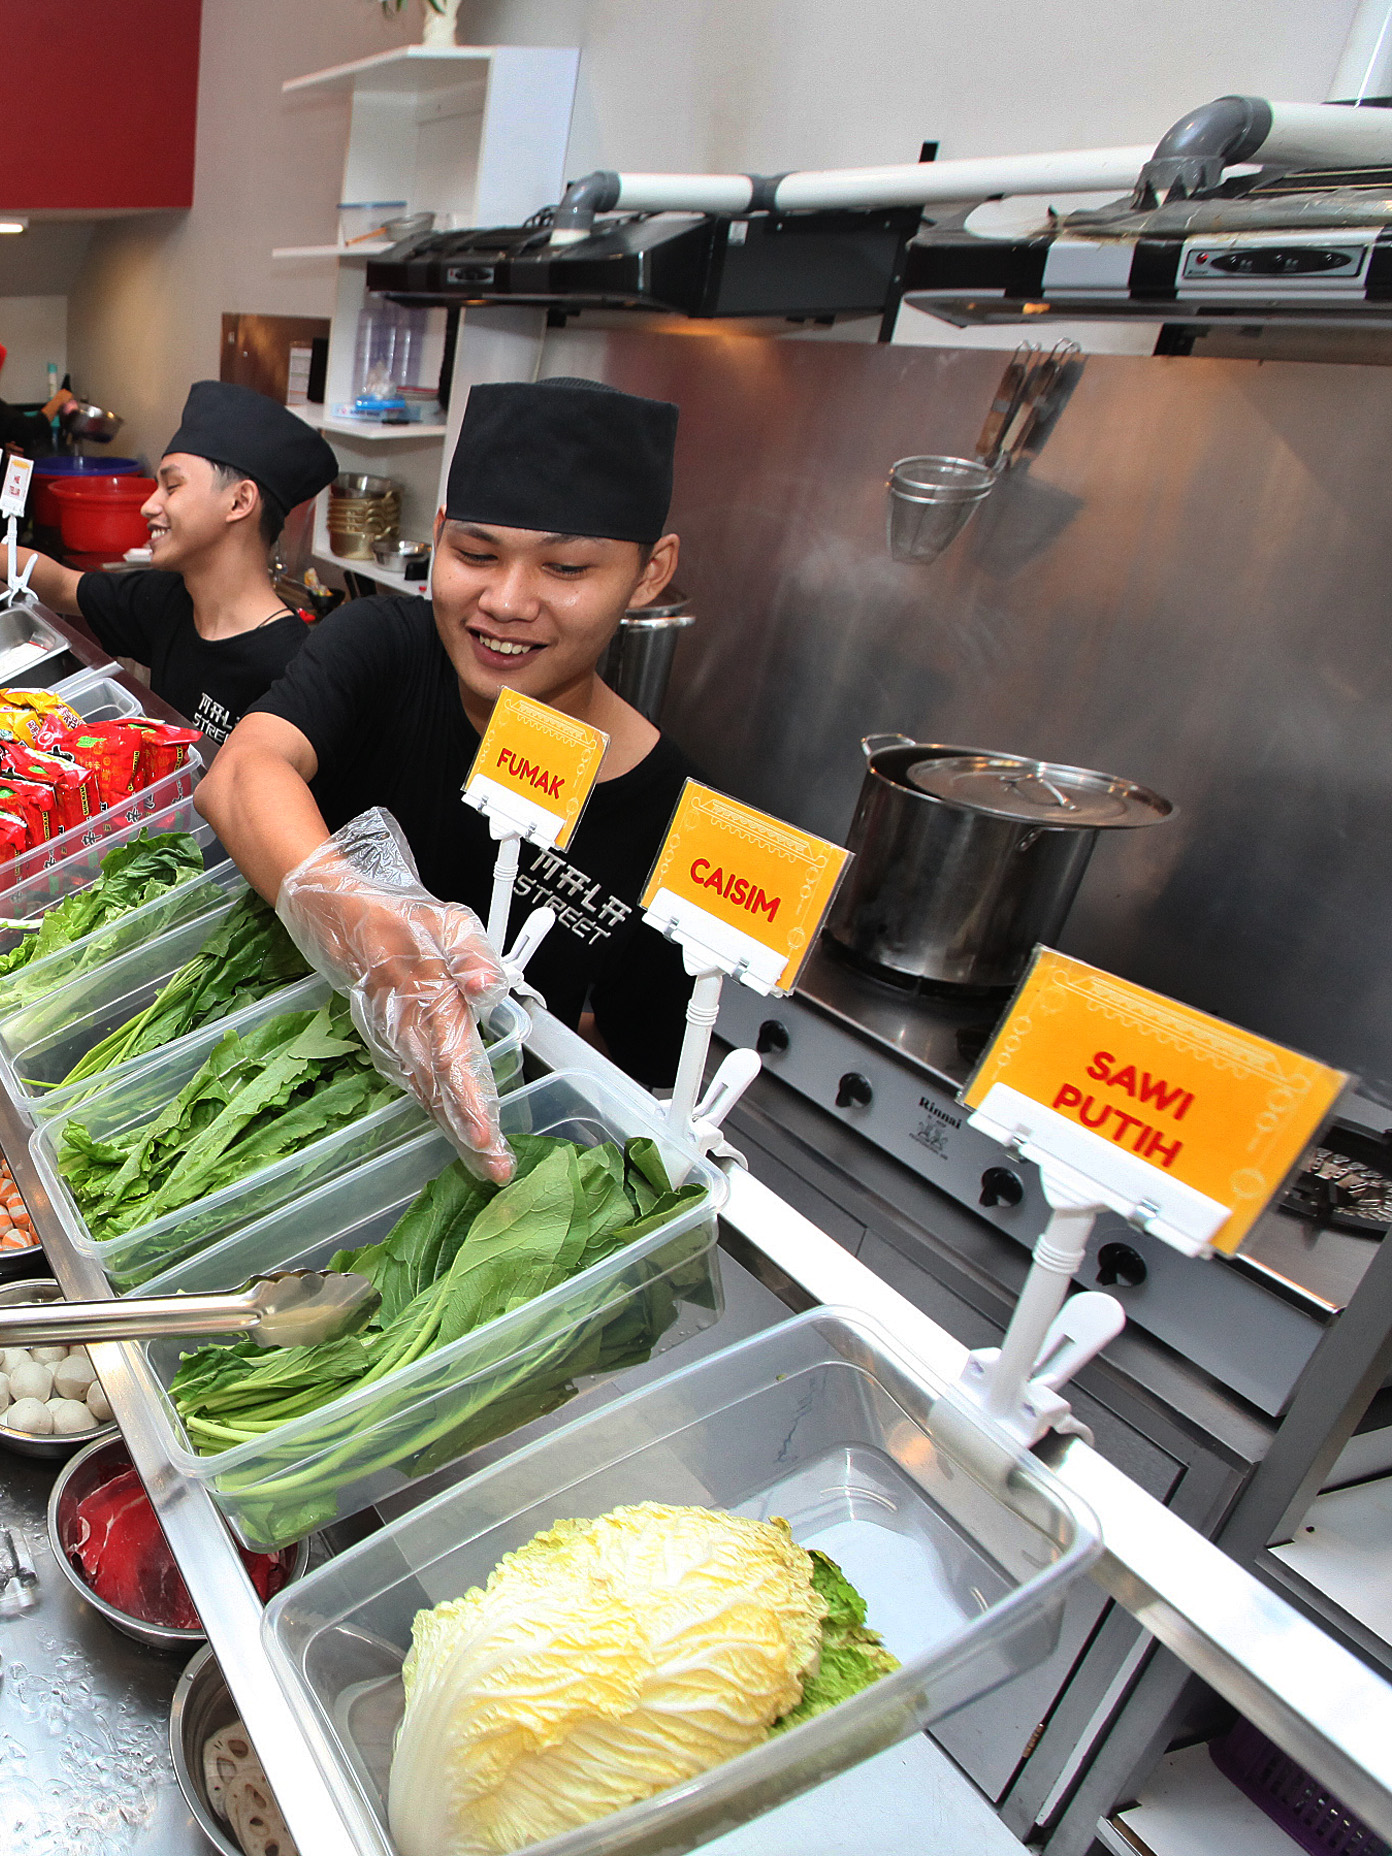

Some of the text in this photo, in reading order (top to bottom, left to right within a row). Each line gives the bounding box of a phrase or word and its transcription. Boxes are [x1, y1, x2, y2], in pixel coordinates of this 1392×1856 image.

[192, 712, 229, 743] STRE
[198, 692, 240, 730] MAL
[496, 747, 565, 799] FUMAK
[513, 874, 612, 945] STREET
[690, 858, 782, 923] CAISIM
[918, 1096, 963, 1130] Rinnai
[1085, 1051, 1196, 1121] SAWI
[1052, 1083, 1183, 1168] PUTIH
